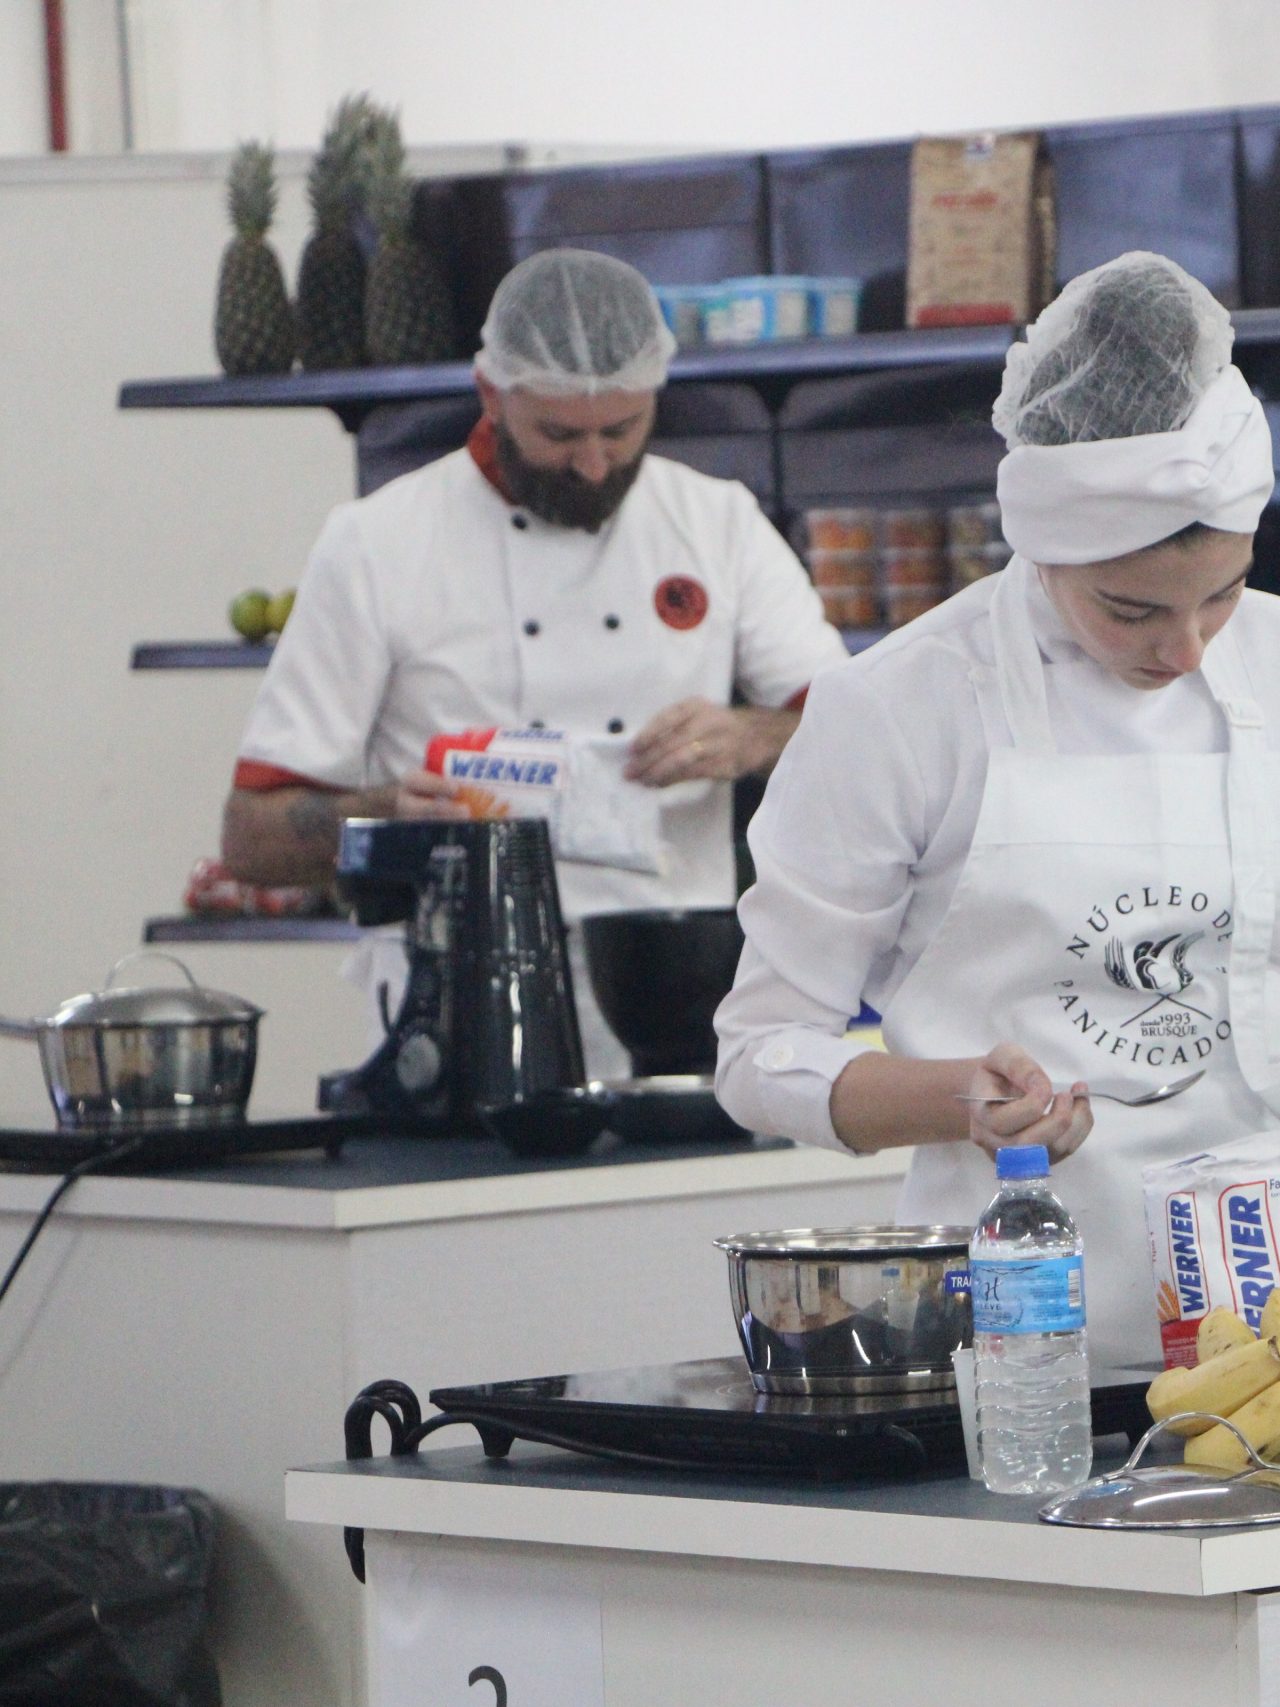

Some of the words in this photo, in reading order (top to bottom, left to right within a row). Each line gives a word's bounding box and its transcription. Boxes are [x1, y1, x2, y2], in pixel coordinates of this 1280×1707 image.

[450, 756, 557, 785] WERNER
[1066, 885, 1209, 960] NÚCLEO
[1054, 978, 1232, 1067] PANIFICADO
[1141, 1025, 1198, 1037] BRUSQUE
[1160, 1012, 1191, 1025] 1993
[951, 1275, 972, 1288] TRA
[1170, 1199, 1205, 1313] WERNER
[1228, 1195, 1276, 1339] ERNER
